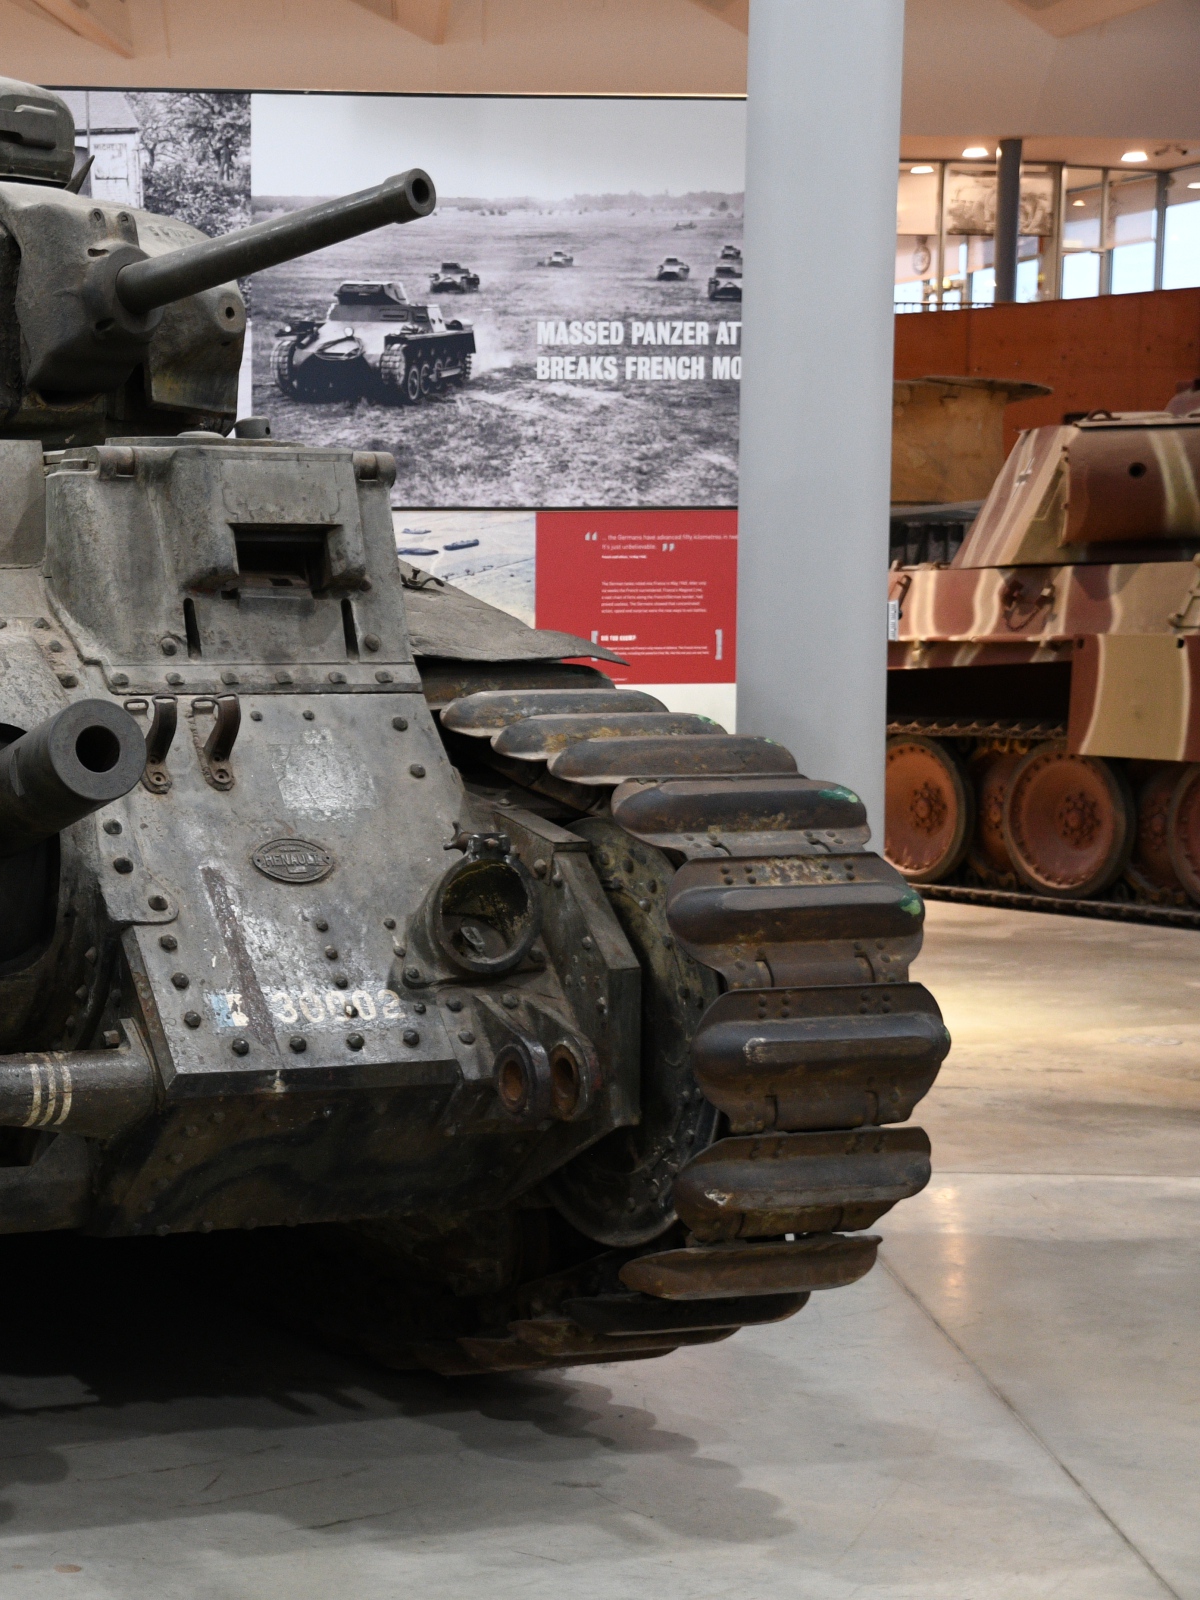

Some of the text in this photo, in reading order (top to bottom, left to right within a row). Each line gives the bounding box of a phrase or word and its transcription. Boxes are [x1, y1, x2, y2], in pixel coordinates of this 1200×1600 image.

[536, 321, 742, 345] MASSED PANZER AT
[536, 355, 742, 380] BREAKS FRENCH MO
[262, 852, 320, 867] RENAULT
